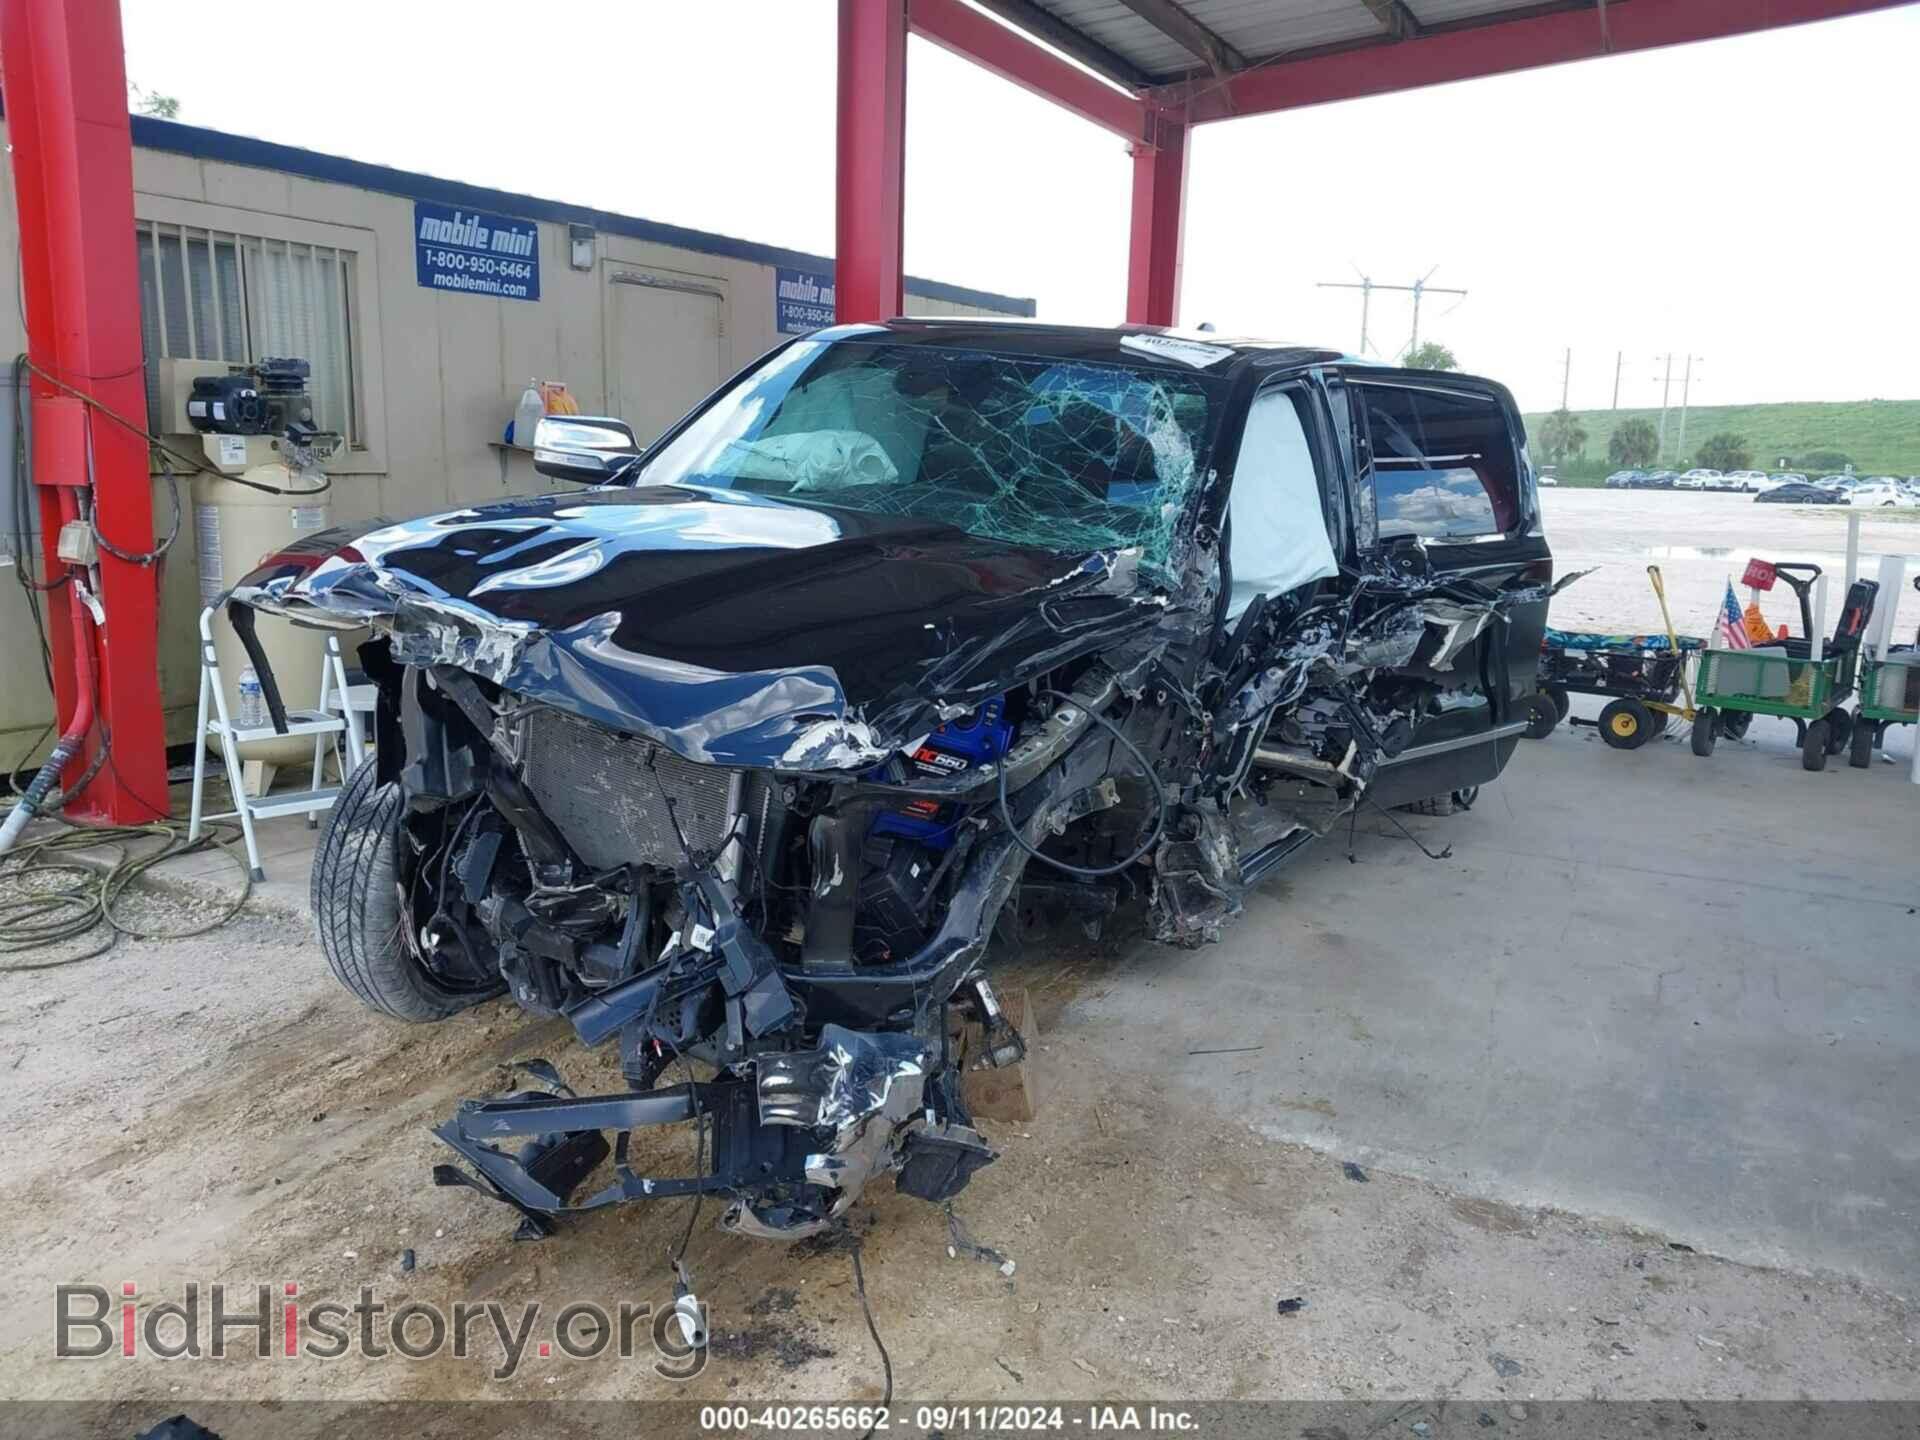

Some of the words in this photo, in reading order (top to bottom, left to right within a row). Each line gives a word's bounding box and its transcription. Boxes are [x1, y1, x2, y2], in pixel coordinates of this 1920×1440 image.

[419, 211, 489, 250] mobile
[491, 226, 537, 257] mini
[425, 249, 531, 280] 1-800-950-6464
[433, 273, 527, 297] mobilemini.com
[779, 274, 819, 303] mobile
[820, 284, 835, 305] mi
[782, 303, 835, 323] 1-800-950-64
